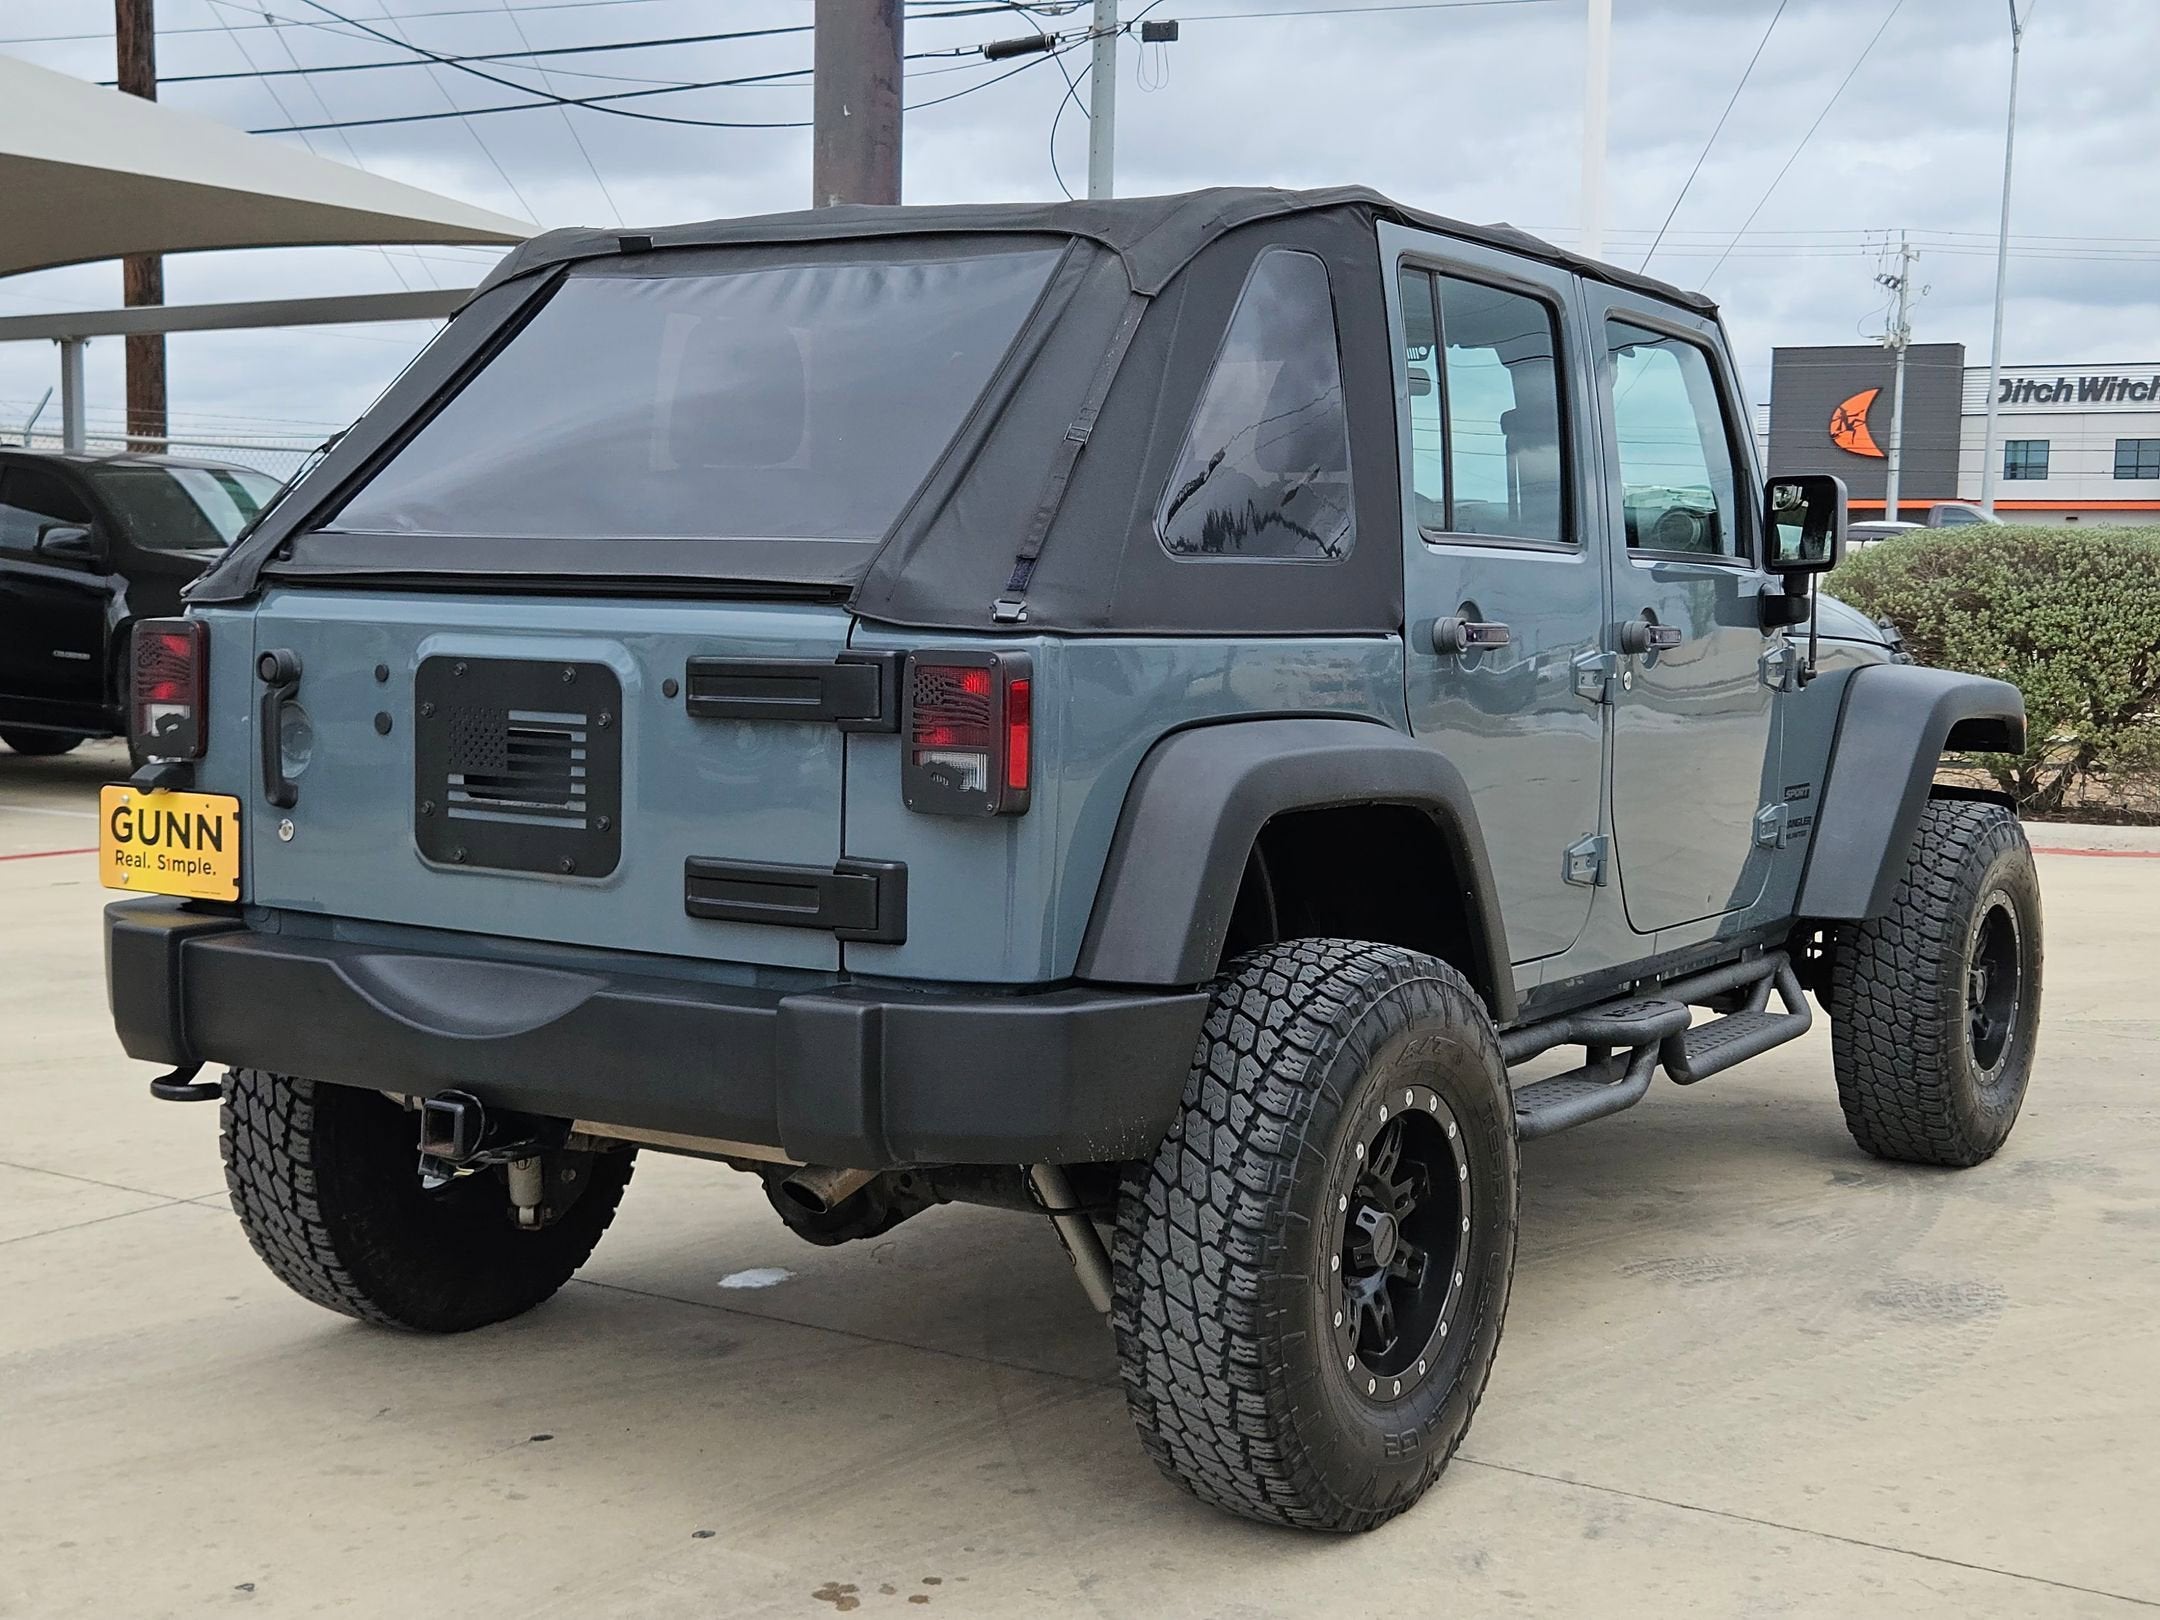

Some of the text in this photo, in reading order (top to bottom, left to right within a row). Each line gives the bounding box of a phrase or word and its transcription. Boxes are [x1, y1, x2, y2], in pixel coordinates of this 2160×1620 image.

[1987, 375, 2160, 403] Ditch Witch
[111, 806, 222, 852] GUNN
[115, 850, 150, 869] Real.
